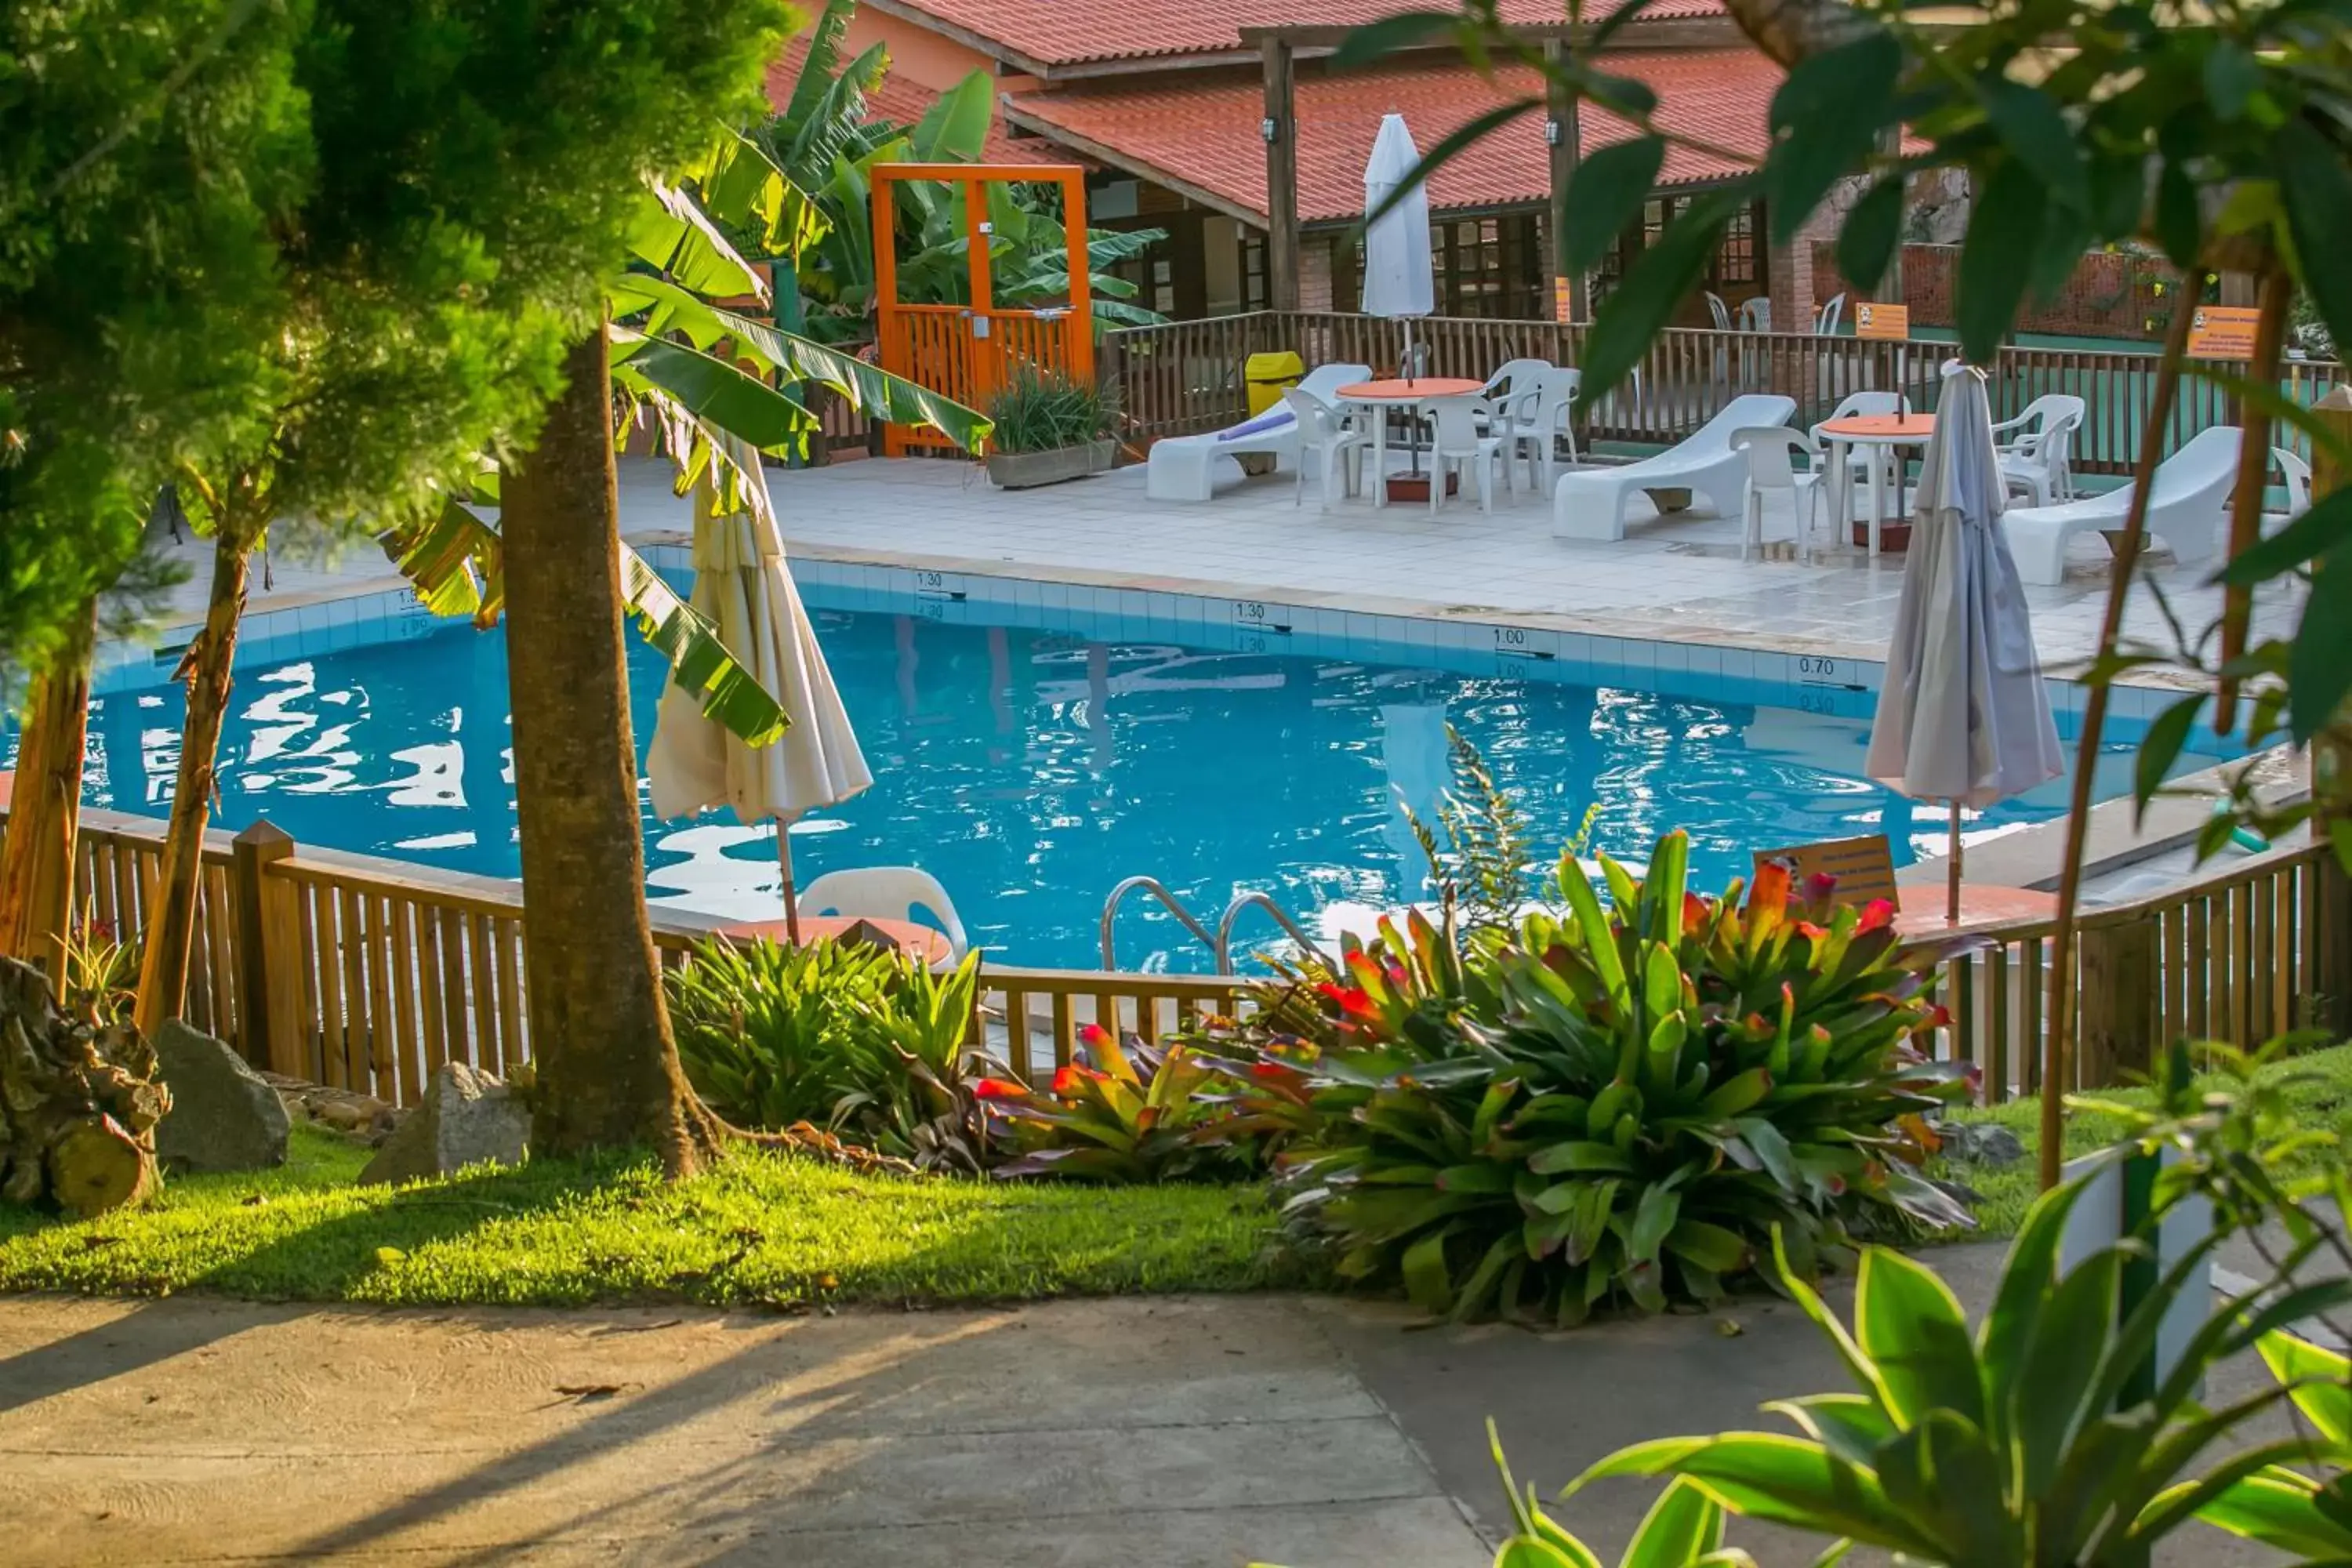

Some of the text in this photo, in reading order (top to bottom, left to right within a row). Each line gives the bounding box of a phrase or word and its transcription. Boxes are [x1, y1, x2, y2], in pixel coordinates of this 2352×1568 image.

[1237, 603, 1265, 619] 1.30
[1494, 629, 1525, 644] 1.00
[1800, 658, 1834, 675] 0.70
